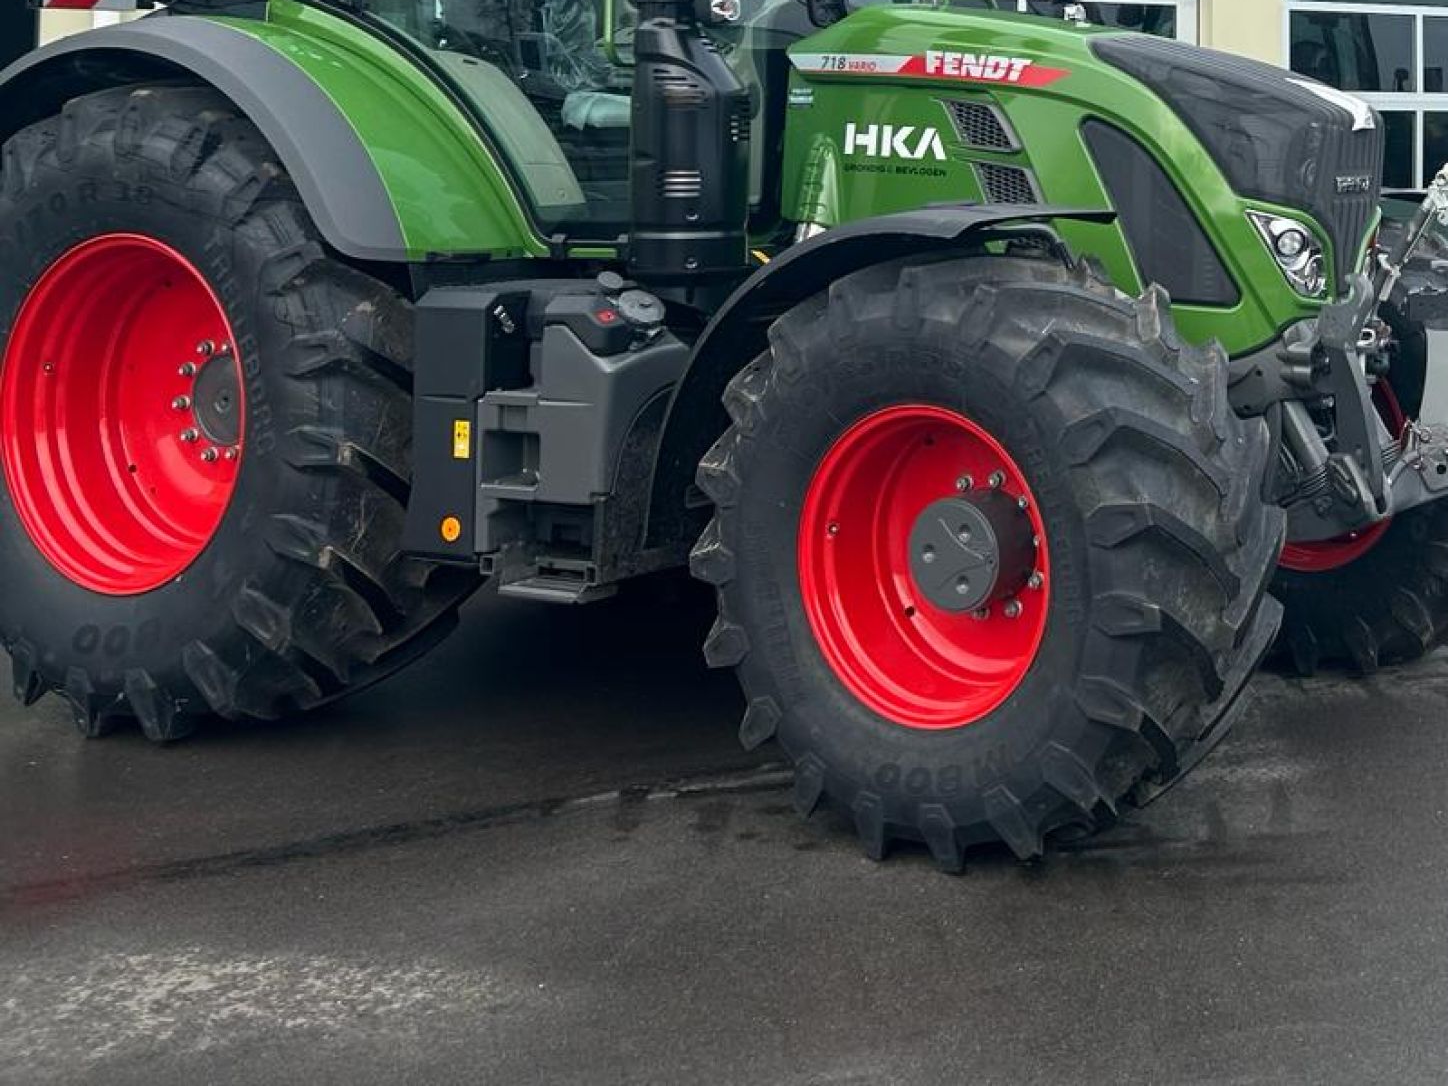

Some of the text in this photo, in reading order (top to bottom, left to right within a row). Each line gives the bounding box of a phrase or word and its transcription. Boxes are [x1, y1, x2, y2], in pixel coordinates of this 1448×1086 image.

[821, 55, 846, 70] 718
[925, 50, 1033, 81] FENDT
[843, 122, 947, 160] HKA
